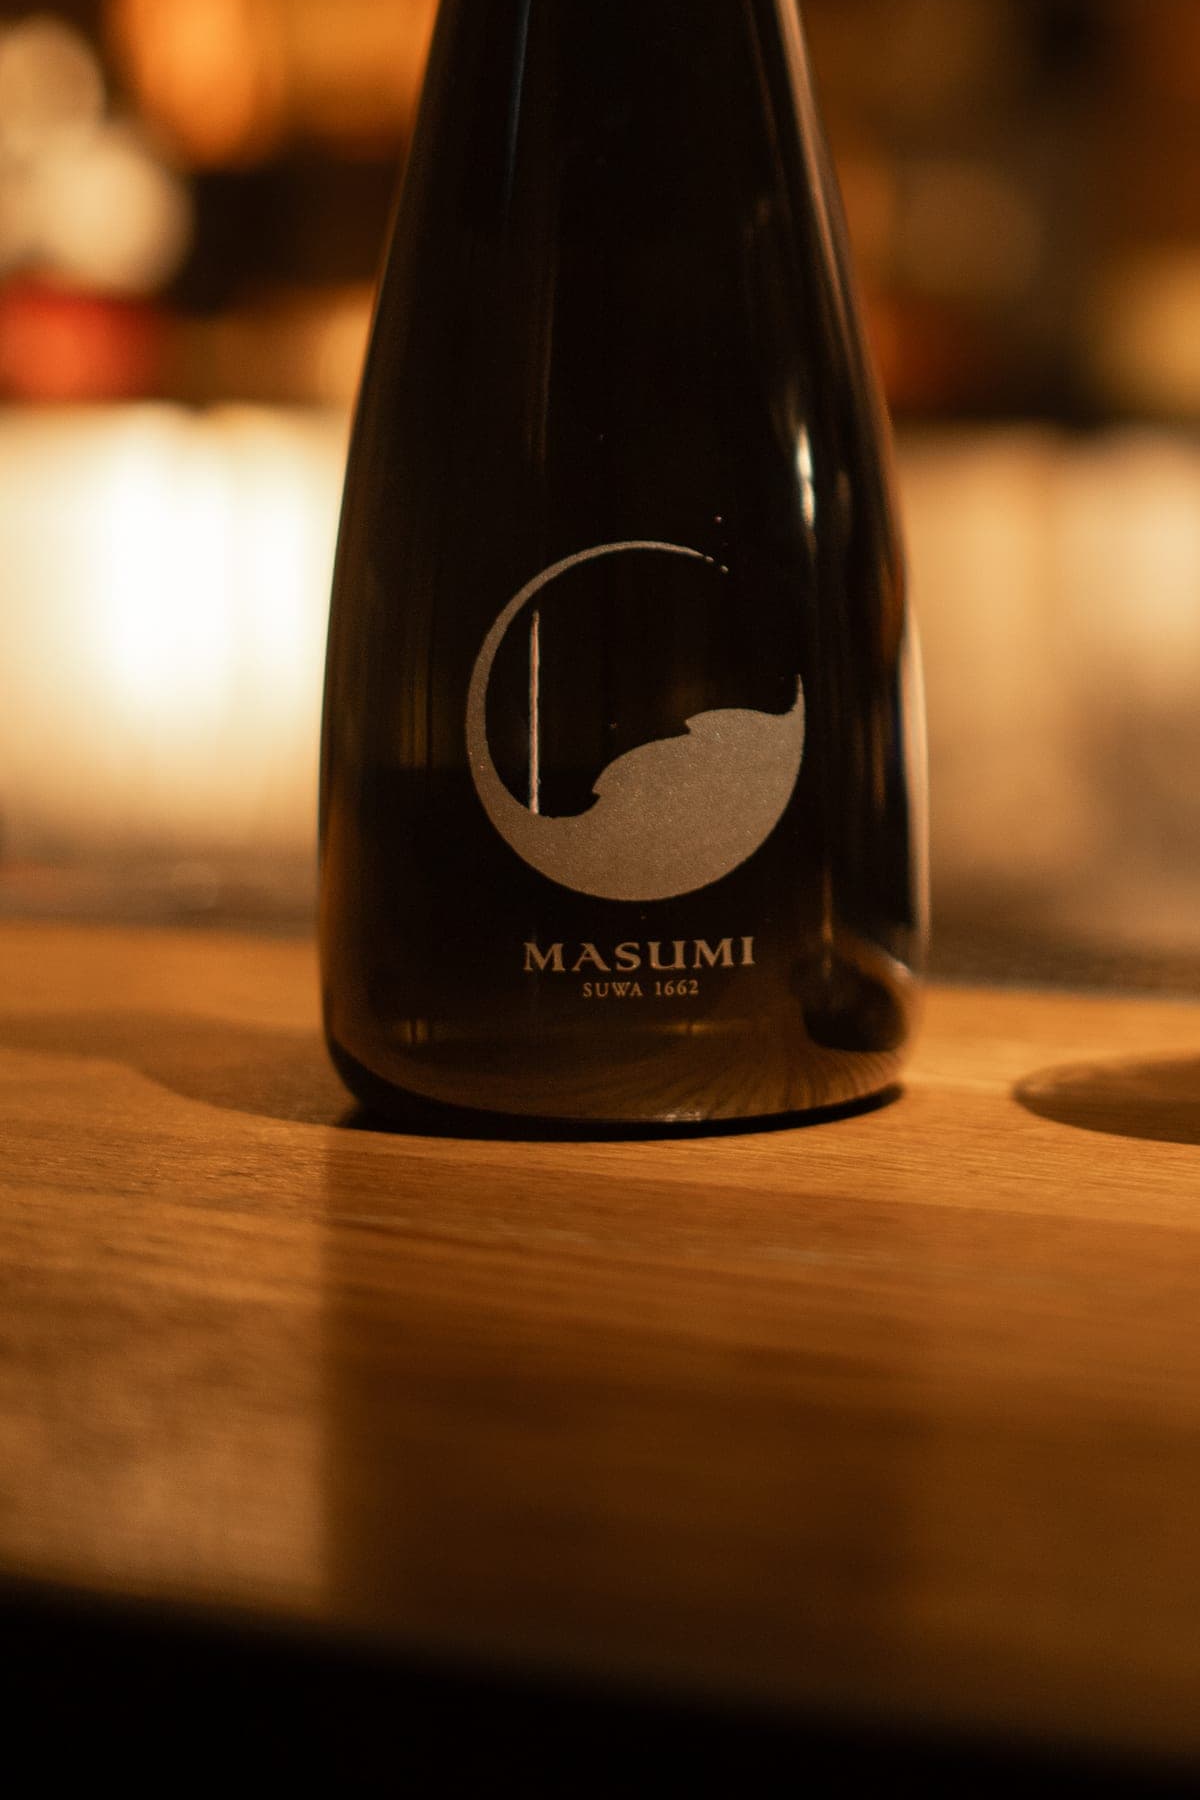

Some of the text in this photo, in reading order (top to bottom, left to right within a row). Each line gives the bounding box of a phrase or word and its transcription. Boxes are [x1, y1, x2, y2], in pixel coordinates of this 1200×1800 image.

[523, 936, 756, 972] MASUMI
[583, 979, 700, 998] SUWA 1662
